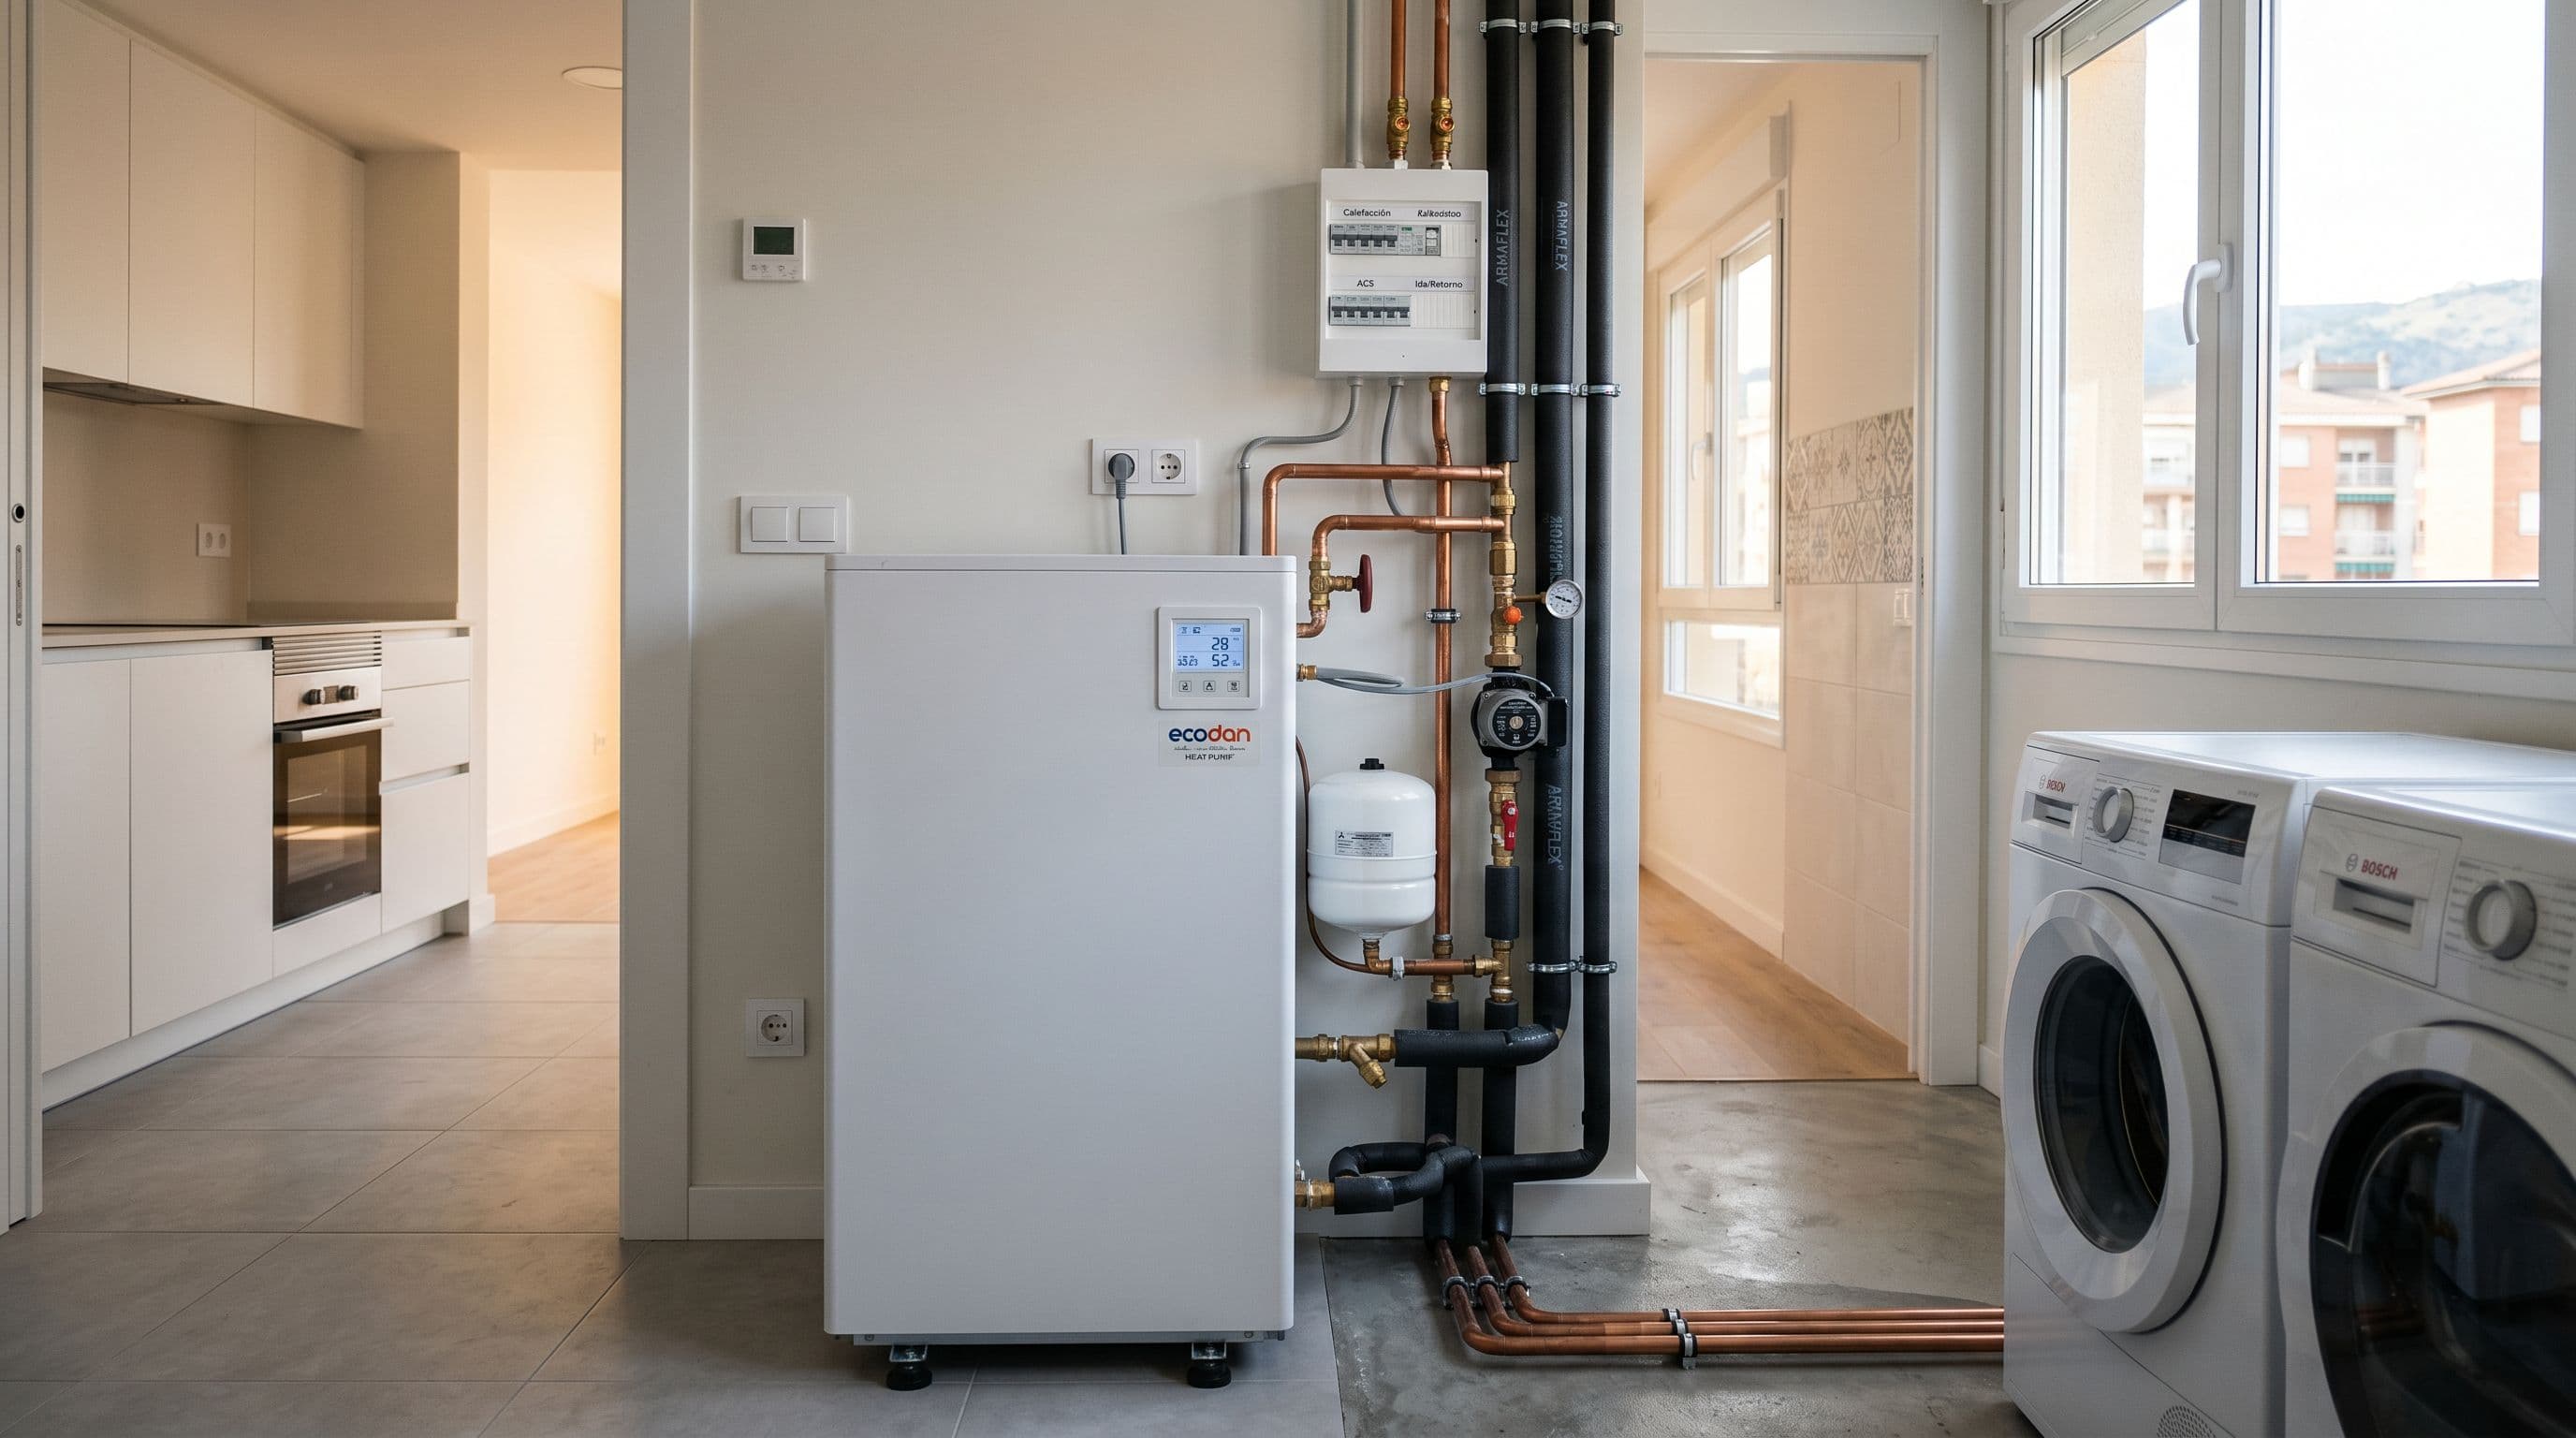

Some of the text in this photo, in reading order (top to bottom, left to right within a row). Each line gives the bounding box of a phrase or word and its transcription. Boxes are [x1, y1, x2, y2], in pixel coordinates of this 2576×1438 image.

[1343, 208, 1391, 217] Calefacción
[1496, 209, 1509, 286] ARMAFLEX
[1356, 279, 1375, 287] ACS
[1414, 280, 1463, 288] Ida/Retorno
[1211, 637, 1229, 651] 28
[1211, 653, 1229, 667] 52
[1168, 724, 1251, 742] ecodan
[2361, 858, 2398, 880] BOSCH
